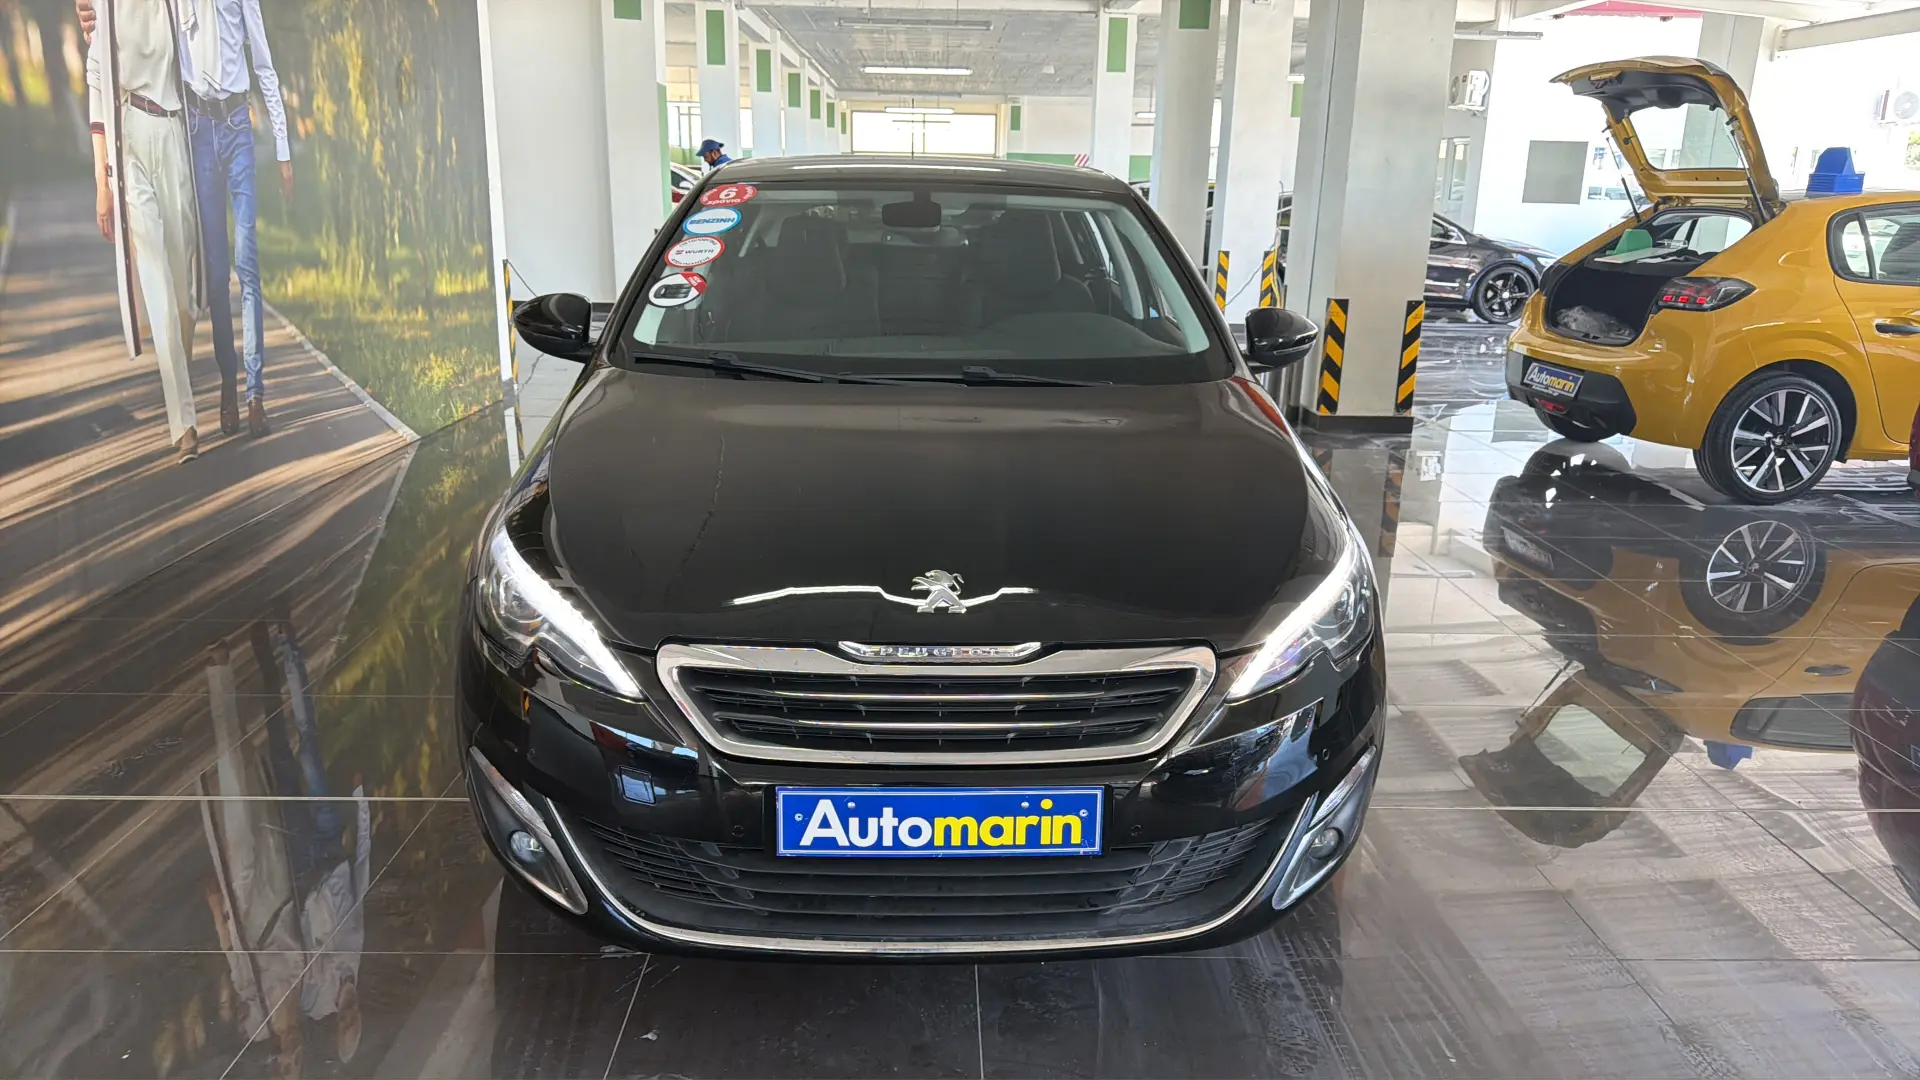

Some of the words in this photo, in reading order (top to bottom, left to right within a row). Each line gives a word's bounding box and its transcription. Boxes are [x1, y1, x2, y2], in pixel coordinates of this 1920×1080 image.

[719, 187, 738, 199] 6
[1528, 366, 1575, 393] Automarin
[799, 798, 1082, 848] Automarin
